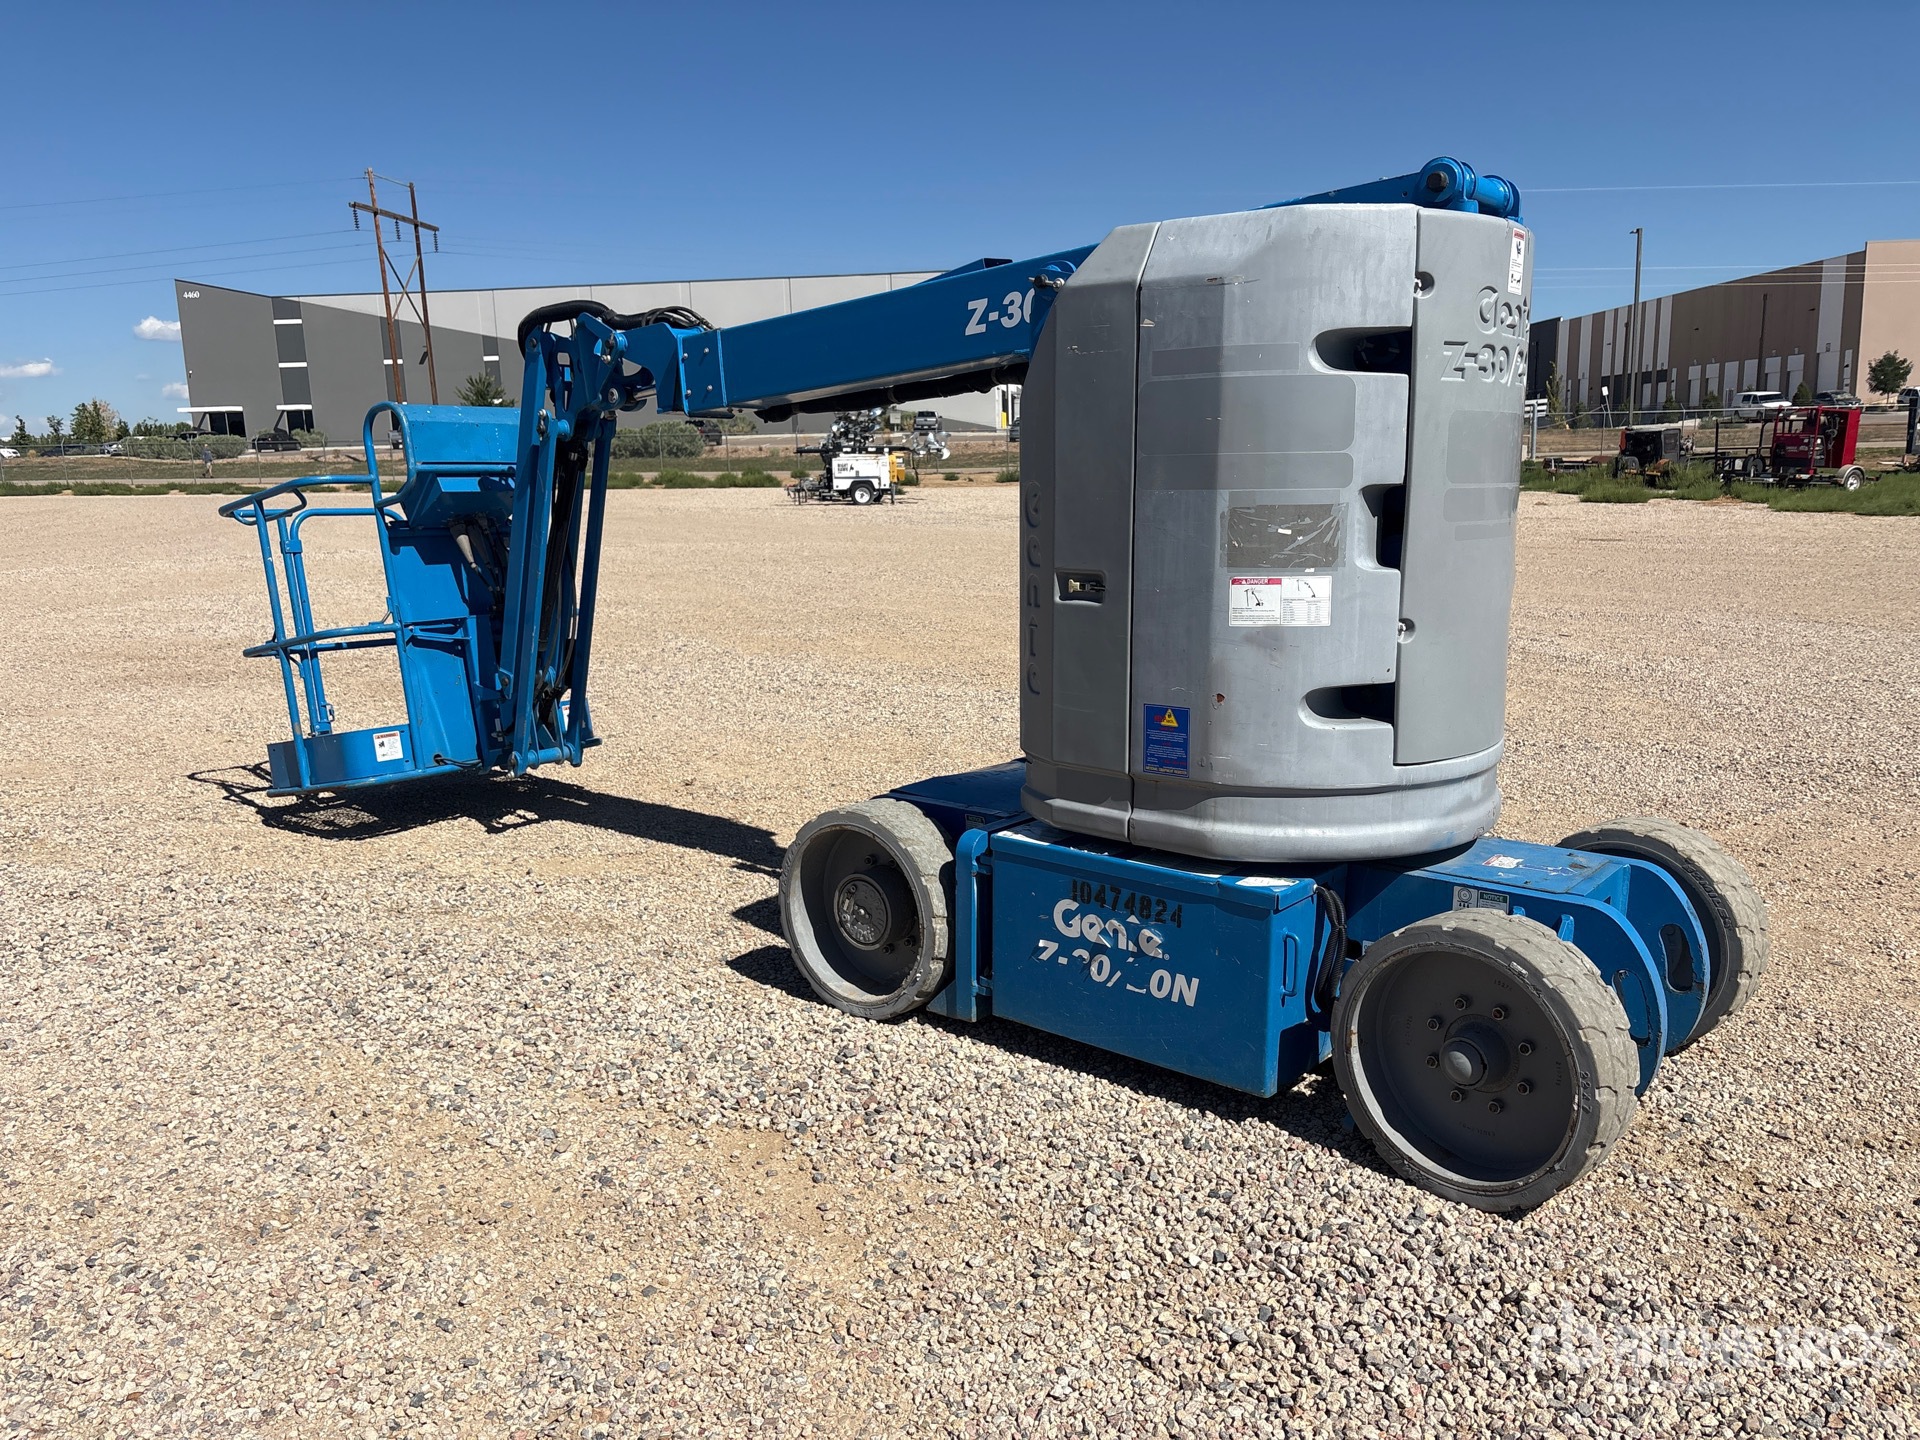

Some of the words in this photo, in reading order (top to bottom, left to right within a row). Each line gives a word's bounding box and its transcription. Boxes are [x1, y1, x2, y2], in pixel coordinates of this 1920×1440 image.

[182, 290, 200, 299] 4460
[1483, 893, 1504, 902] NOTICE
[1071, 879, 1183, 928] 10474824
